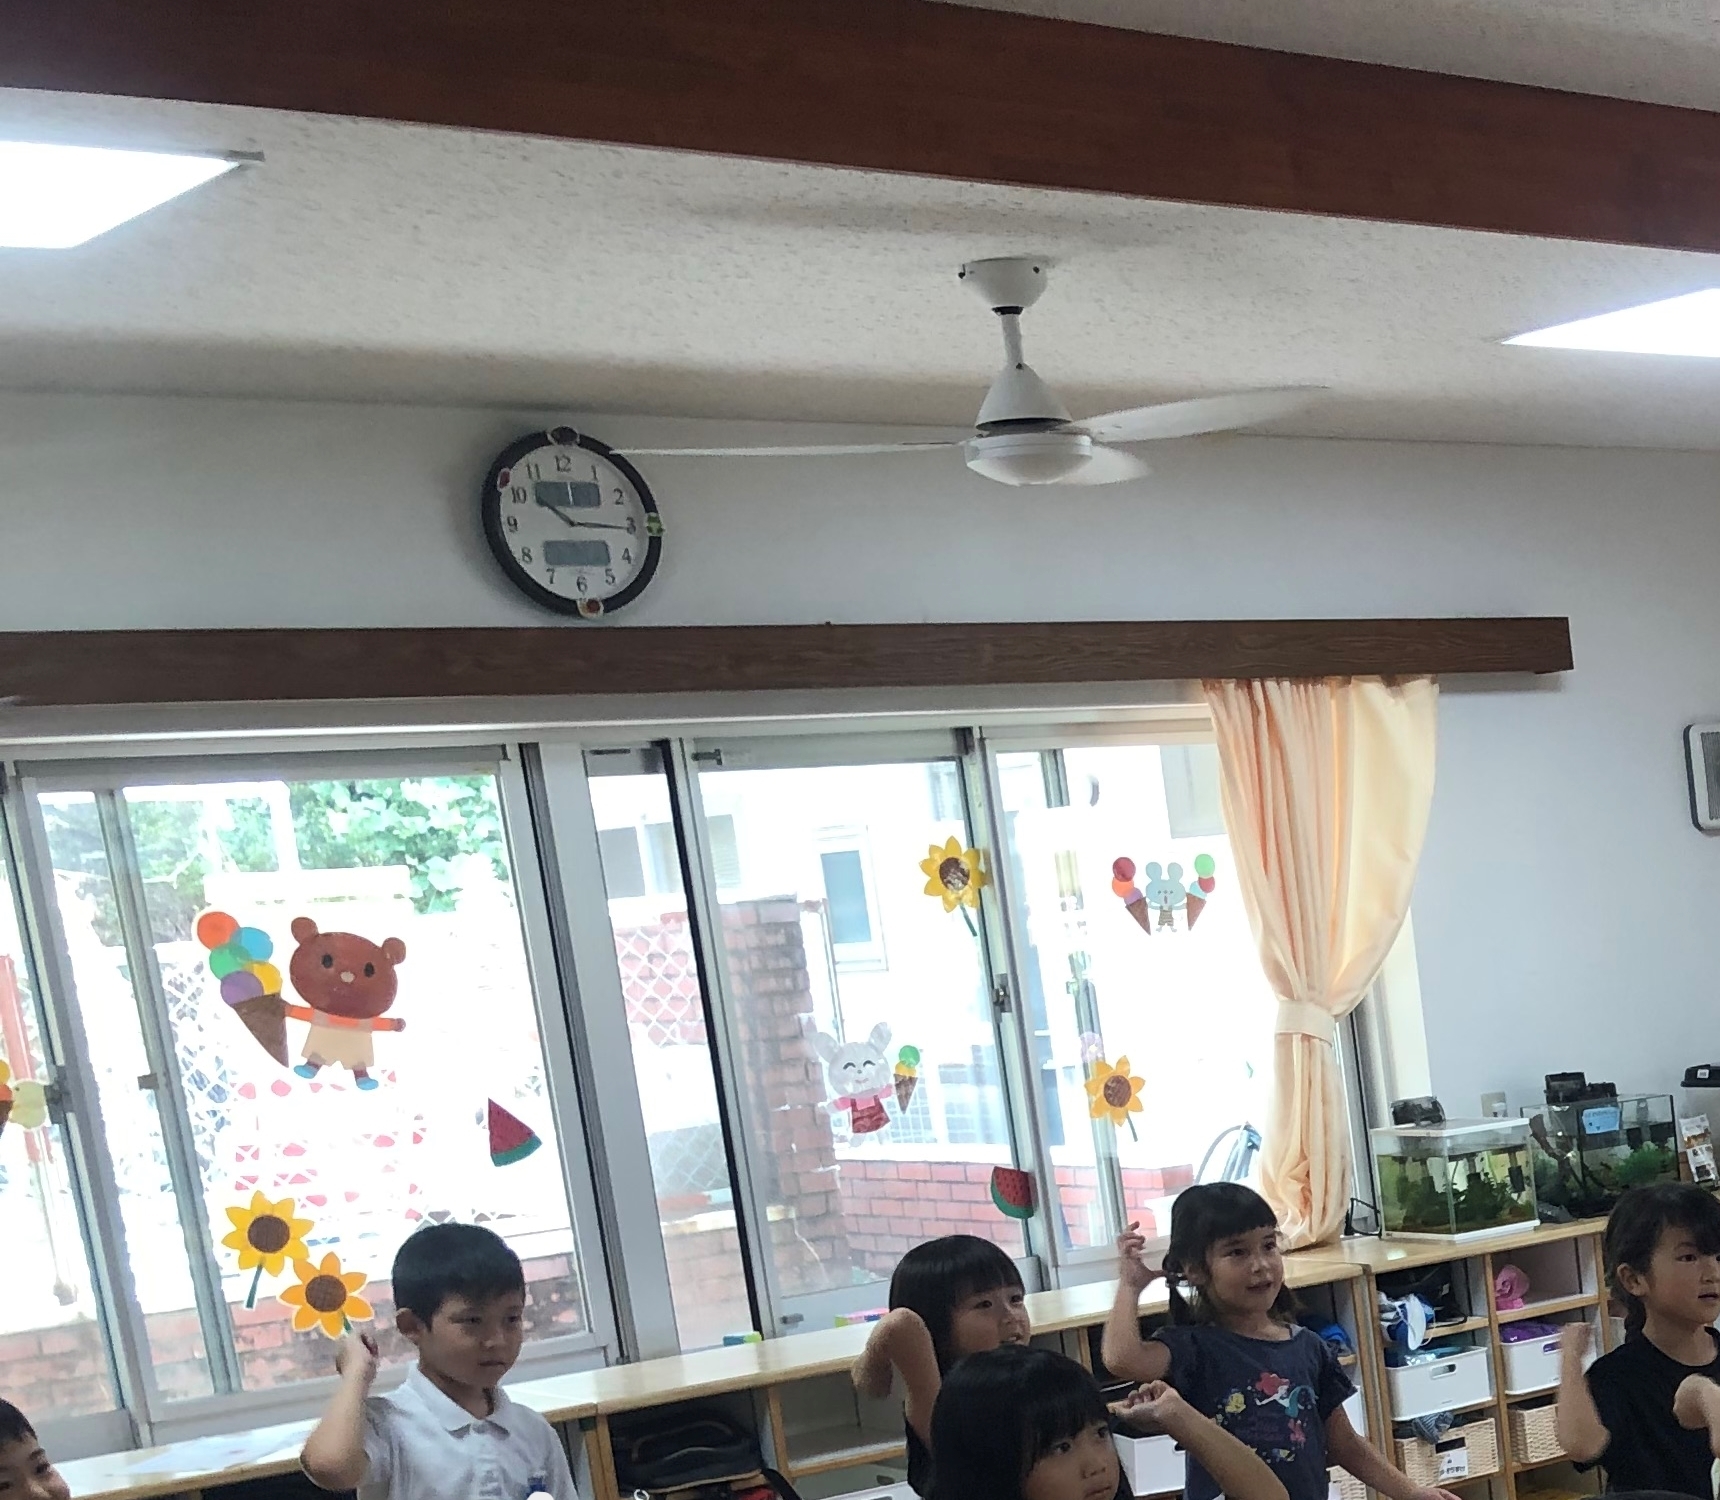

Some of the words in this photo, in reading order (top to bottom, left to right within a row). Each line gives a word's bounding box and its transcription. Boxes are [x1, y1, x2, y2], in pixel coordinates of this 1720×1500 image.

[527, 463, 541, 480] 11
[554, 455, 571, 473] 12
[591, 465, 598, 481] 1
[511, 487, 527, 504] 10
[613, 488, 624, 505] 2
[507, 516, 519, 533] 9
[626, 517, 636, 534] 3
[521, 547, 532, 564] 8
[621, 547, 631, 564] 4
[546, 568, 555, 585] 7
[576, 576, 588, 593] 6
[605, 569, 616, 585] 5
